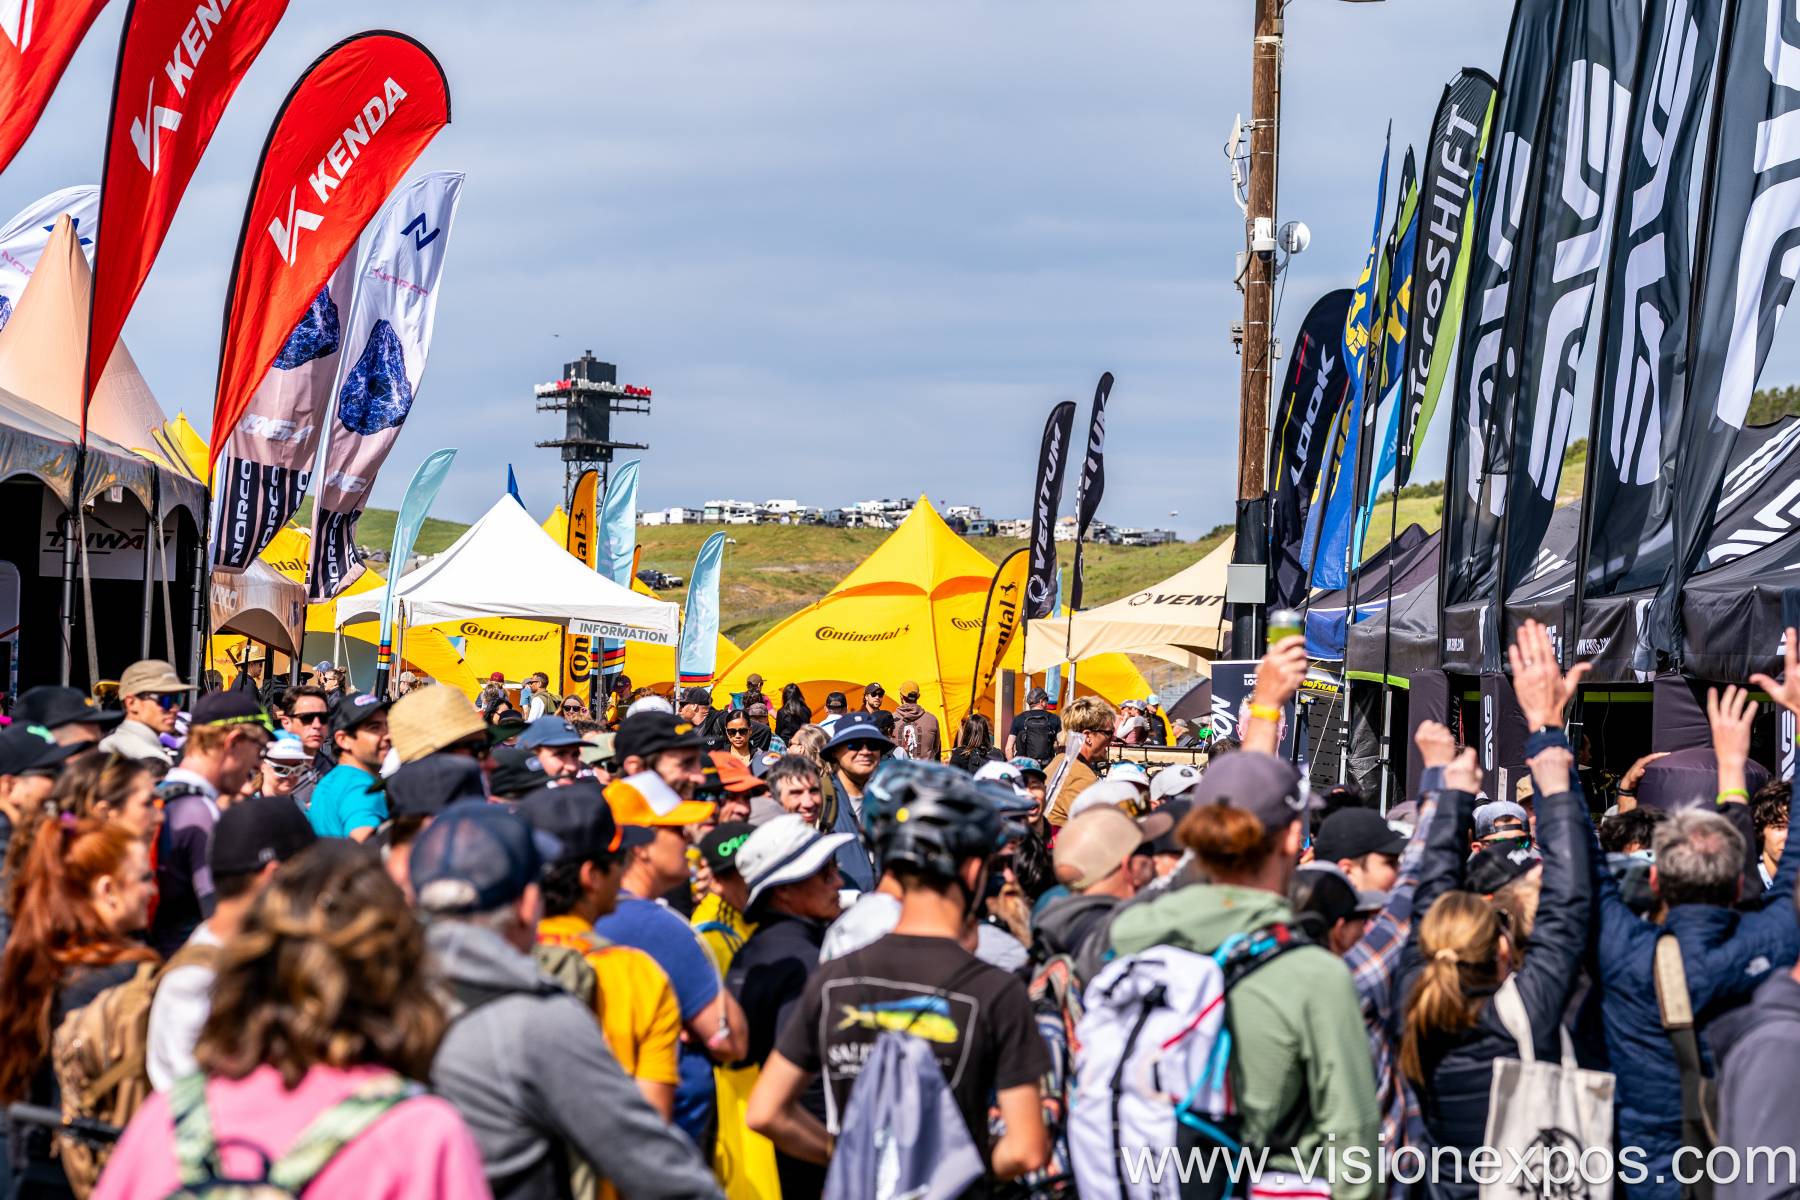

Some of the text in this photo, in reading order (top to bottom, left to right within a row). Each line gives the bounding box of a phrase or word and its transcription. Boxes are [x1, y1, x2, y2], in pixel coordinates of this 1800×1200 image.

[164, 0, 232, 98] KEN
[308, 76, 408, 204] KENDA
[1290, 343, 1335, 487] LOOK
[230, 459, 252, 564] NORCO
[258, 466, 281, 553] ORCO
[1035, 421, 1062, 570] VENTUM
[460, 621, 549, 643] Continental
[579, 622, 668, 644] INFORMATION
[815, 626, 900, 642] Continental
[1153, 594, 1225, 607] VENT
